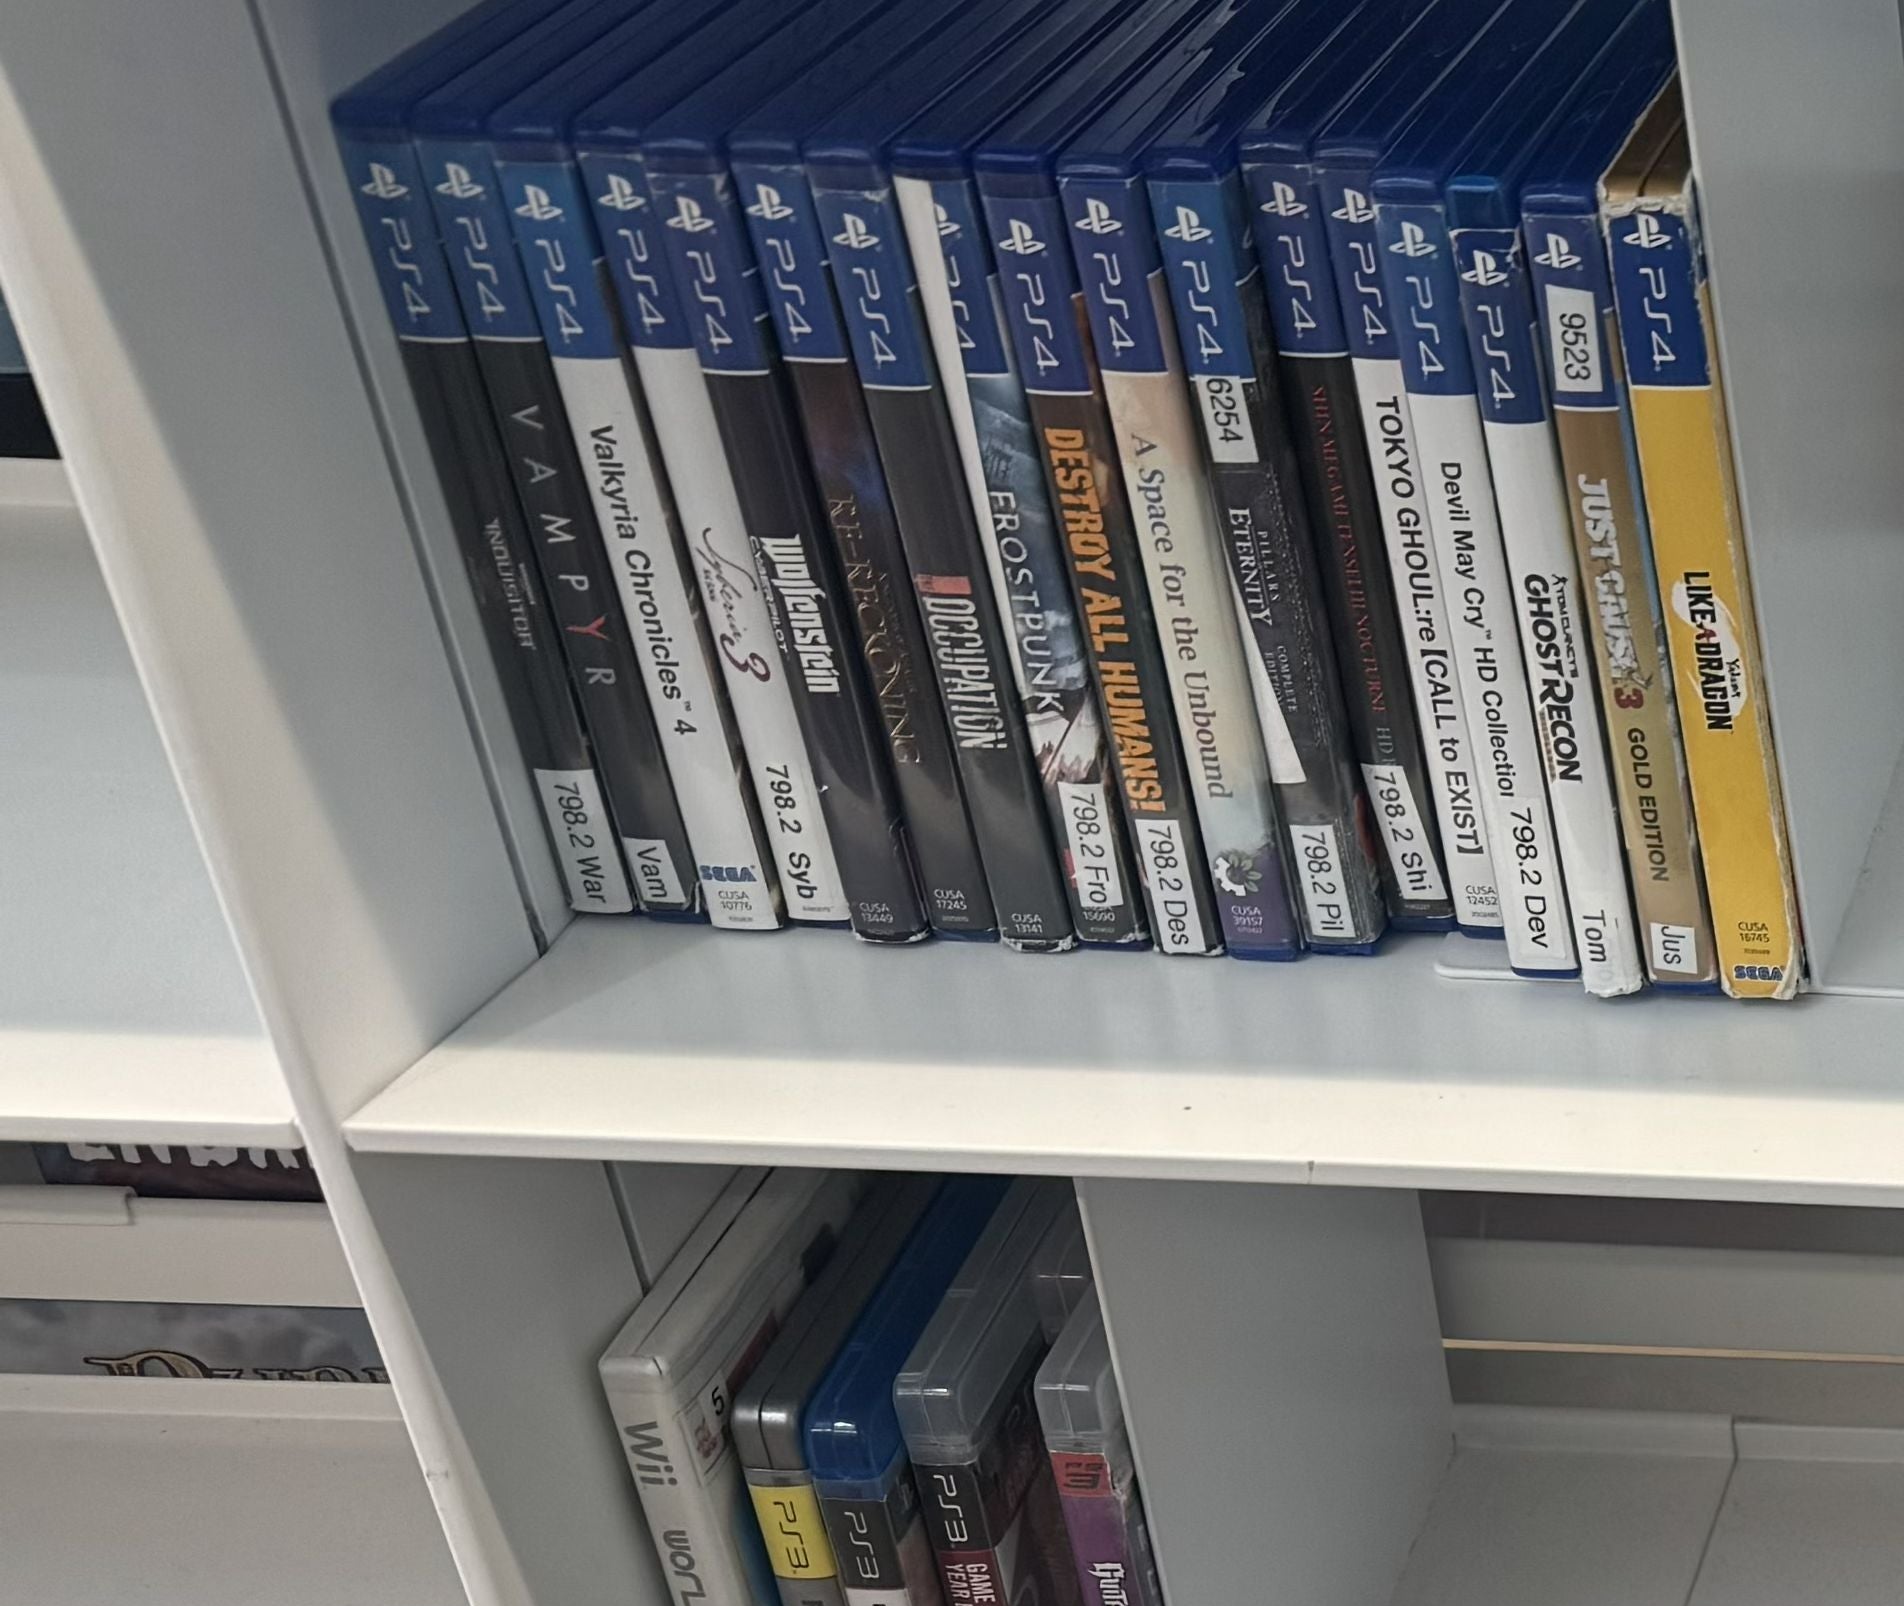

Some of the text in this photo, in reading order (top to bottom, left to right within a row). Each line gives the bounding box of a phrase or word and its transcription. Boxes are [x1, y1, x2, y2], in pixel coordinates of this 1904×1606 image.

[534, 237, 584, 340] PS4
[1640, 268, 1677, 367] PS4
[1557, 311, 1591, 381] 9523
[1205, 376, 1243, 443] 6254
[1440, 462, 1470, 523] Devil
[511, 405, 616, 686] VAMPYR
[589, 424, 636, 540] Valkyria
[673, 719, 697, 735] 4
[1228, 507, 1273, 626] ETERNITY
[1452, 529, 1477, 579] May
[986, 491, 1064, 714] FROSTPUNK
[1043, 427, 1168, 813] DESTROY ALL HUMANS!
[1131, 433, 1235, 799] A Space for the Unbound
[1684, 571, 1717, 624] LIKE
[922, 596, 1008, 751] OCCUPATION
[1474, 646, 1497, 682] HD
[1695, 641, 1733, 730] DRAGON
[1628, 728, 1671, 882] GOLD EDITION
[700, 865, 757, 882] SEGA
[1069, 793, 1109, 906] 798.2 Fro
[934, 889, 965, 900] CUSA
[1582, 910, 1606, 963] Tom
[1662, 927, 1682, 965] Jus
[1734, 965, 1783, 982] SEGA
[624, 1421, 678, 1486] Wii
[934, 1475, 968, 1543] PS3
[844, 1511, 880, 1580] PS3
[946, 1565, 970, 1599] YEAR
[966, 1564, 996, 1604] GAME
